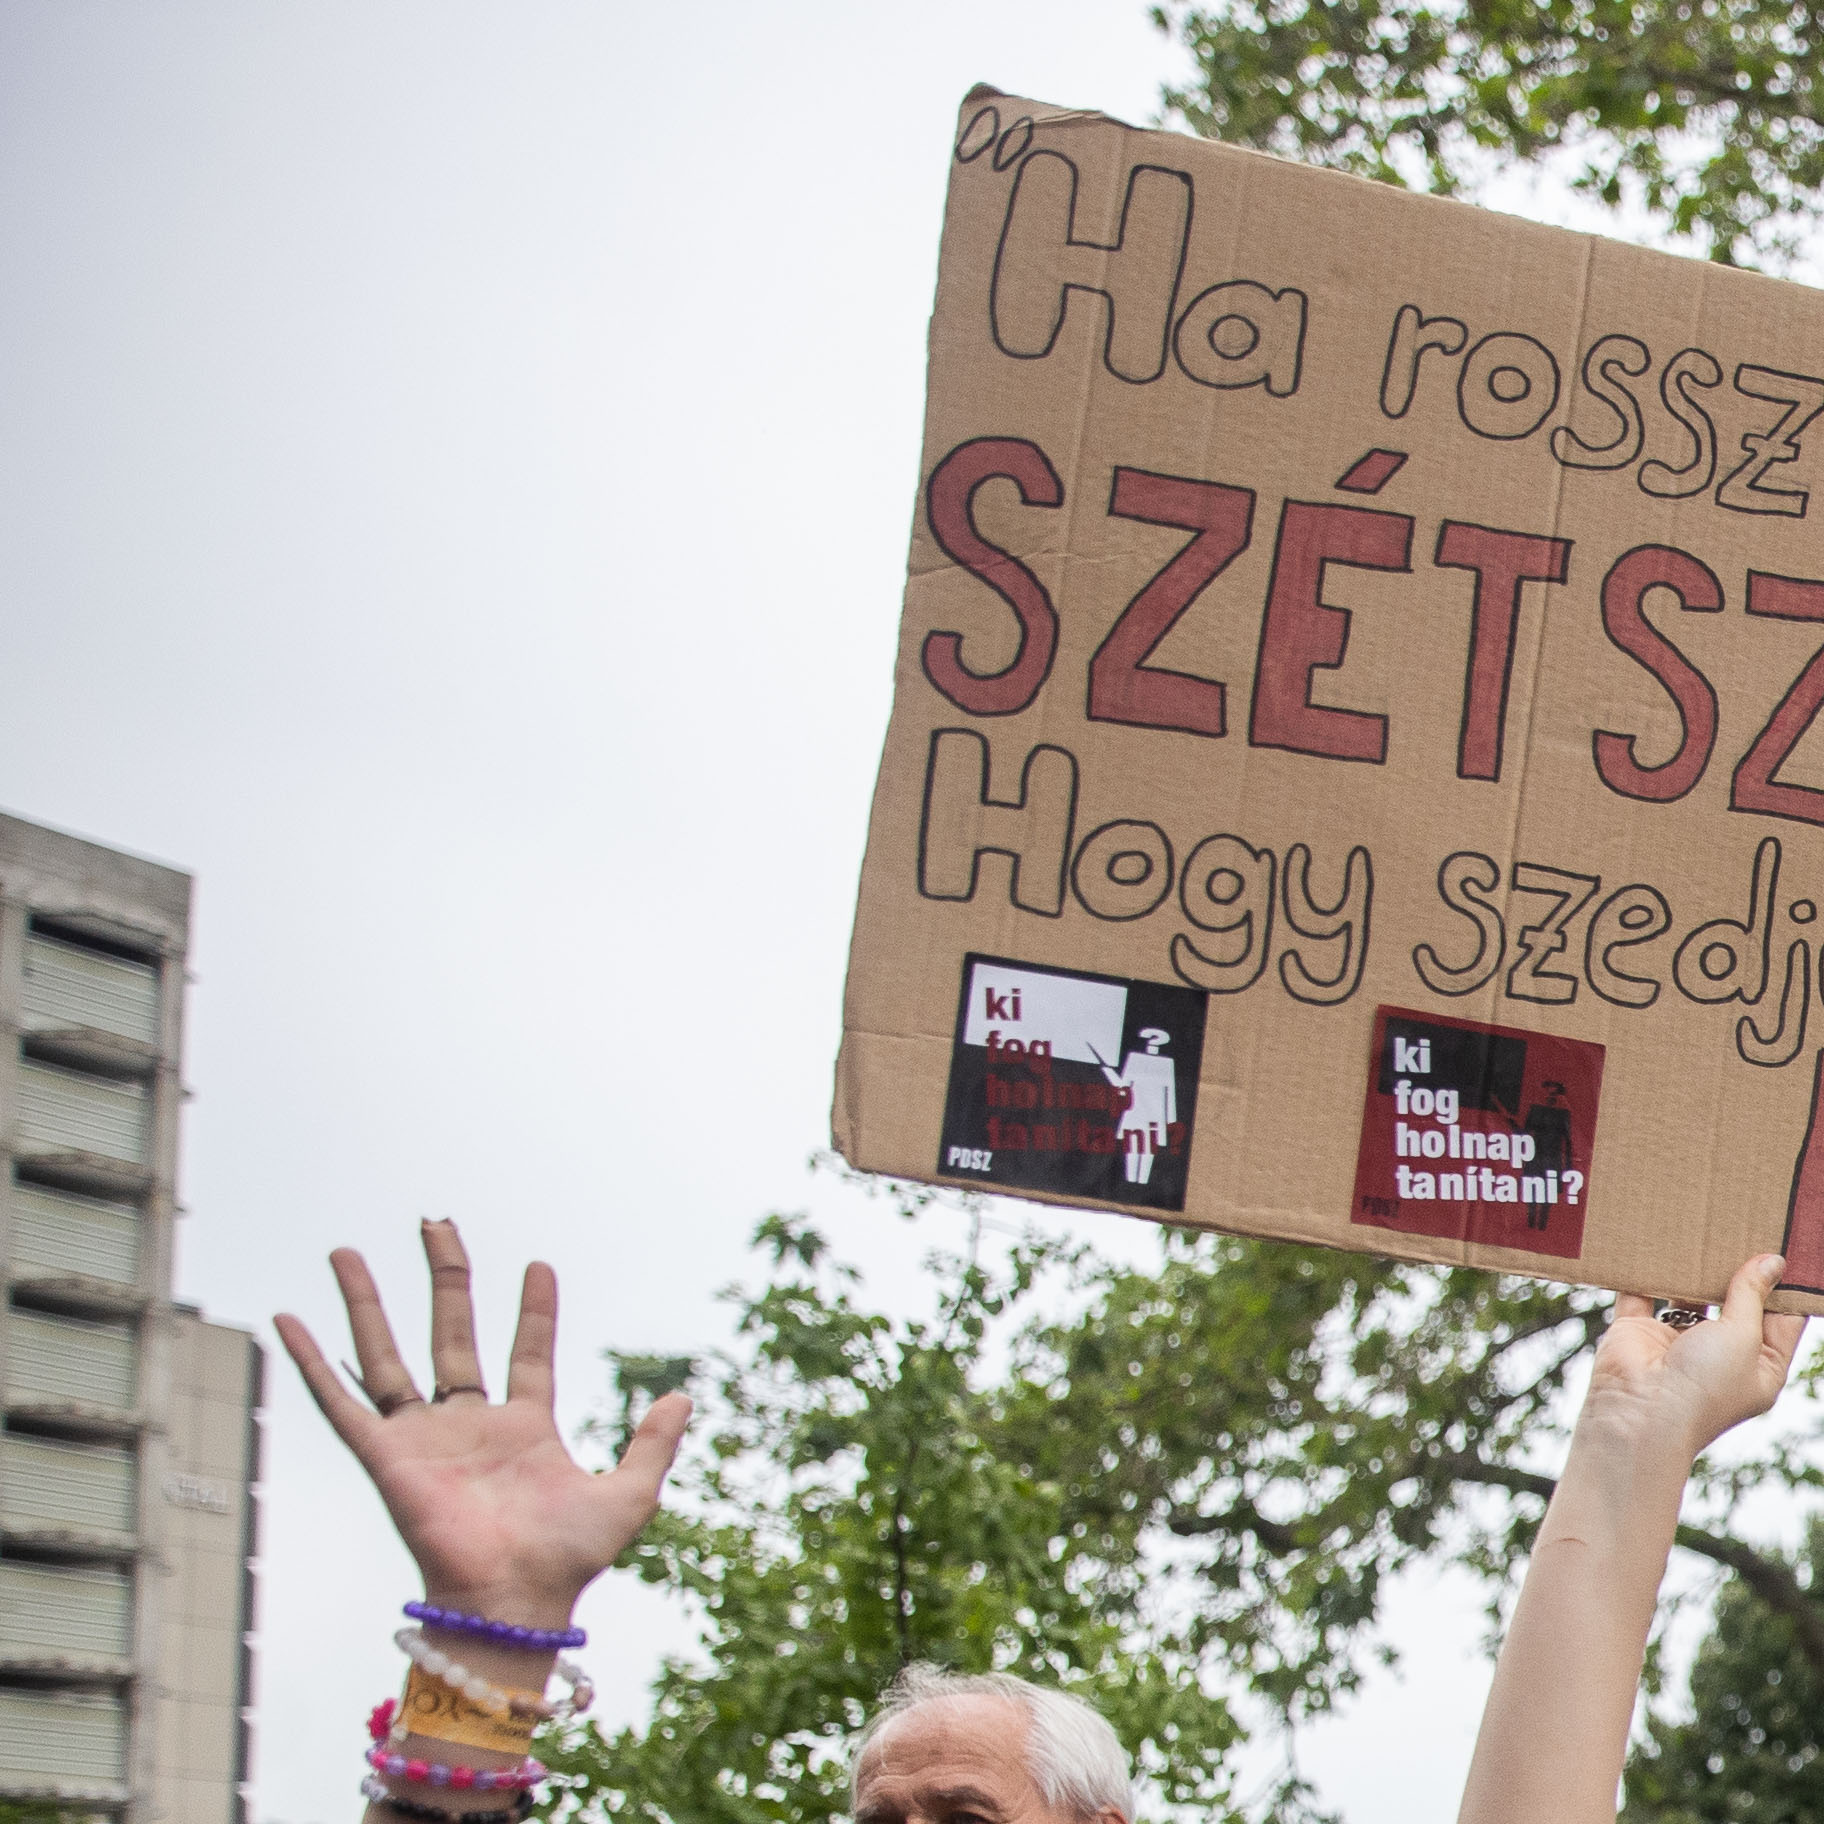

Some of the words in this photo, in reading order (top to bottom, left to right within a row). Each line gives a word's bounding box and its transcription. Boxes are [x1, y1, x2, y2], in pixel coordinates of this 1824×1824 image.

[919, 725, 1372, 1006] Hogy
[985, 987, 1021, 1021] ki
[986, 1030, 1051, 1075] fog
[1394, 1037, 1431, 1073] ki
[1394, 1080, 1459, 1124] fog
[948, 1147, 992, 1171] PDSZ
[1395, 1122, 1535, 1168] holnap
[1396, 1165, 1583, 1204] tanítani?
